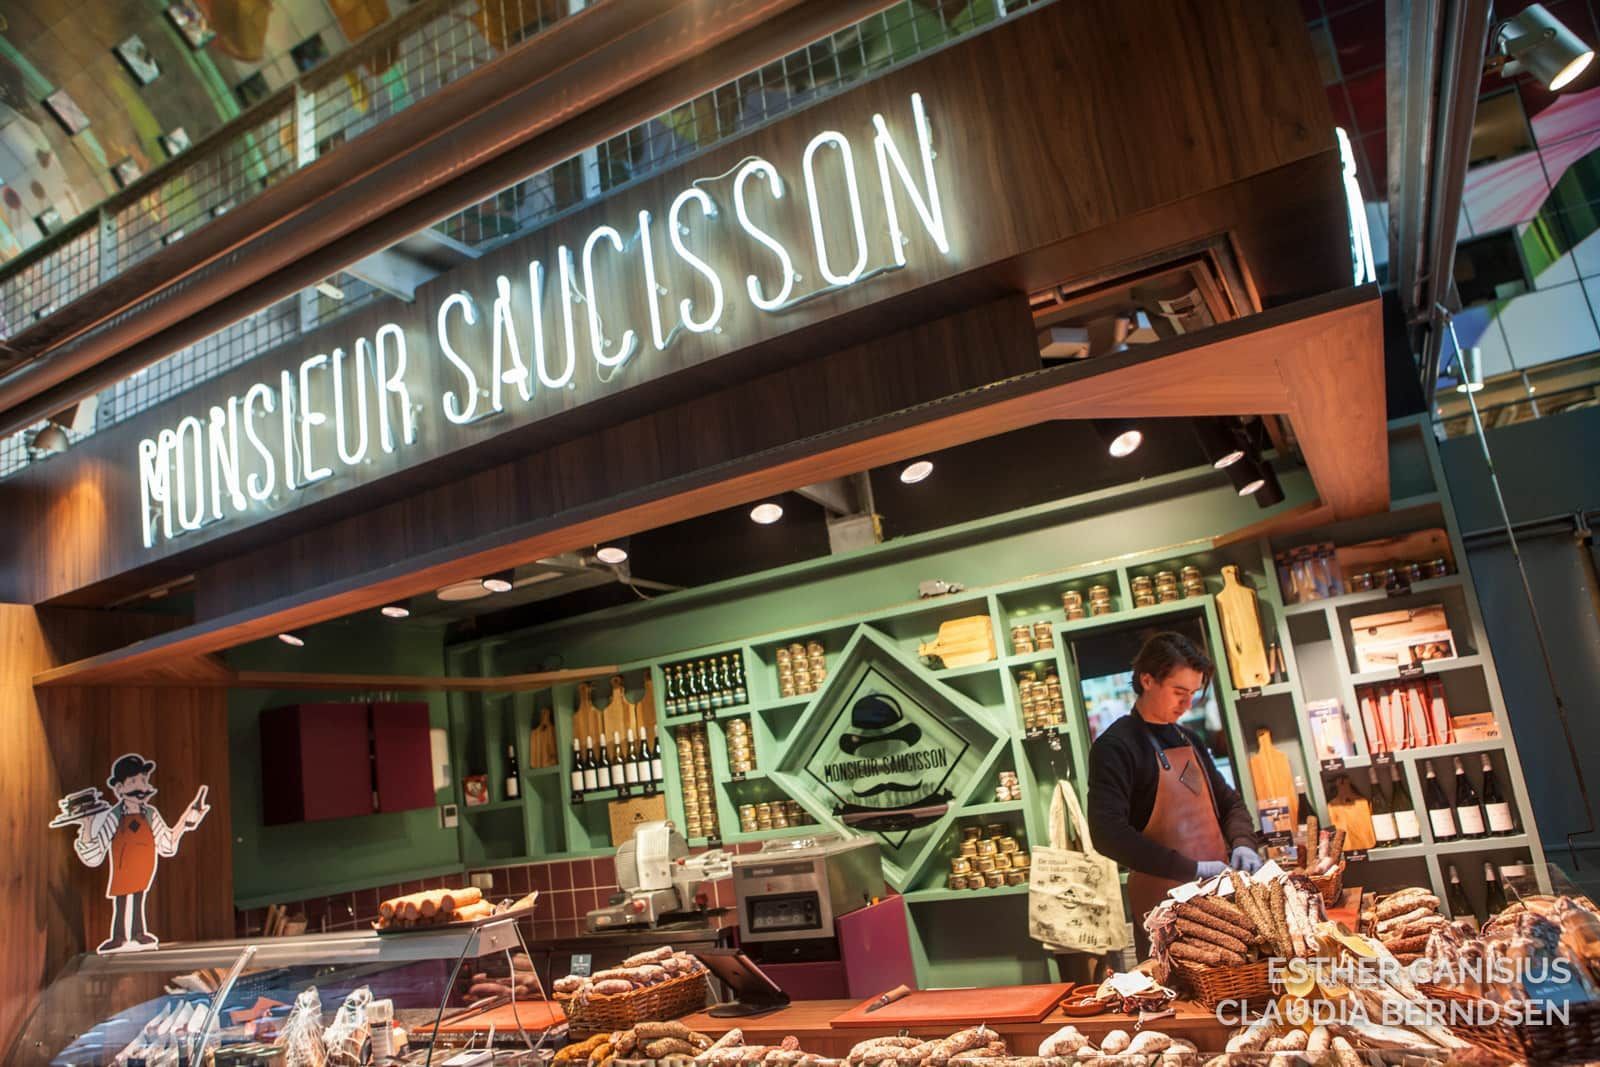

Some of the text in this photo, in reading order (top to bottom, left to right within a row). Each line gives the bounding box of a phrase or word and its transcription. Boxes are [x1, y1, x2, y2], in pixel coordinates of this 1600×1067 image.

[137, 92, 950, 549] MONSIEUR SAUCISSON
[824, 748, 947, 783] MONSIEUR SAUCISSON
